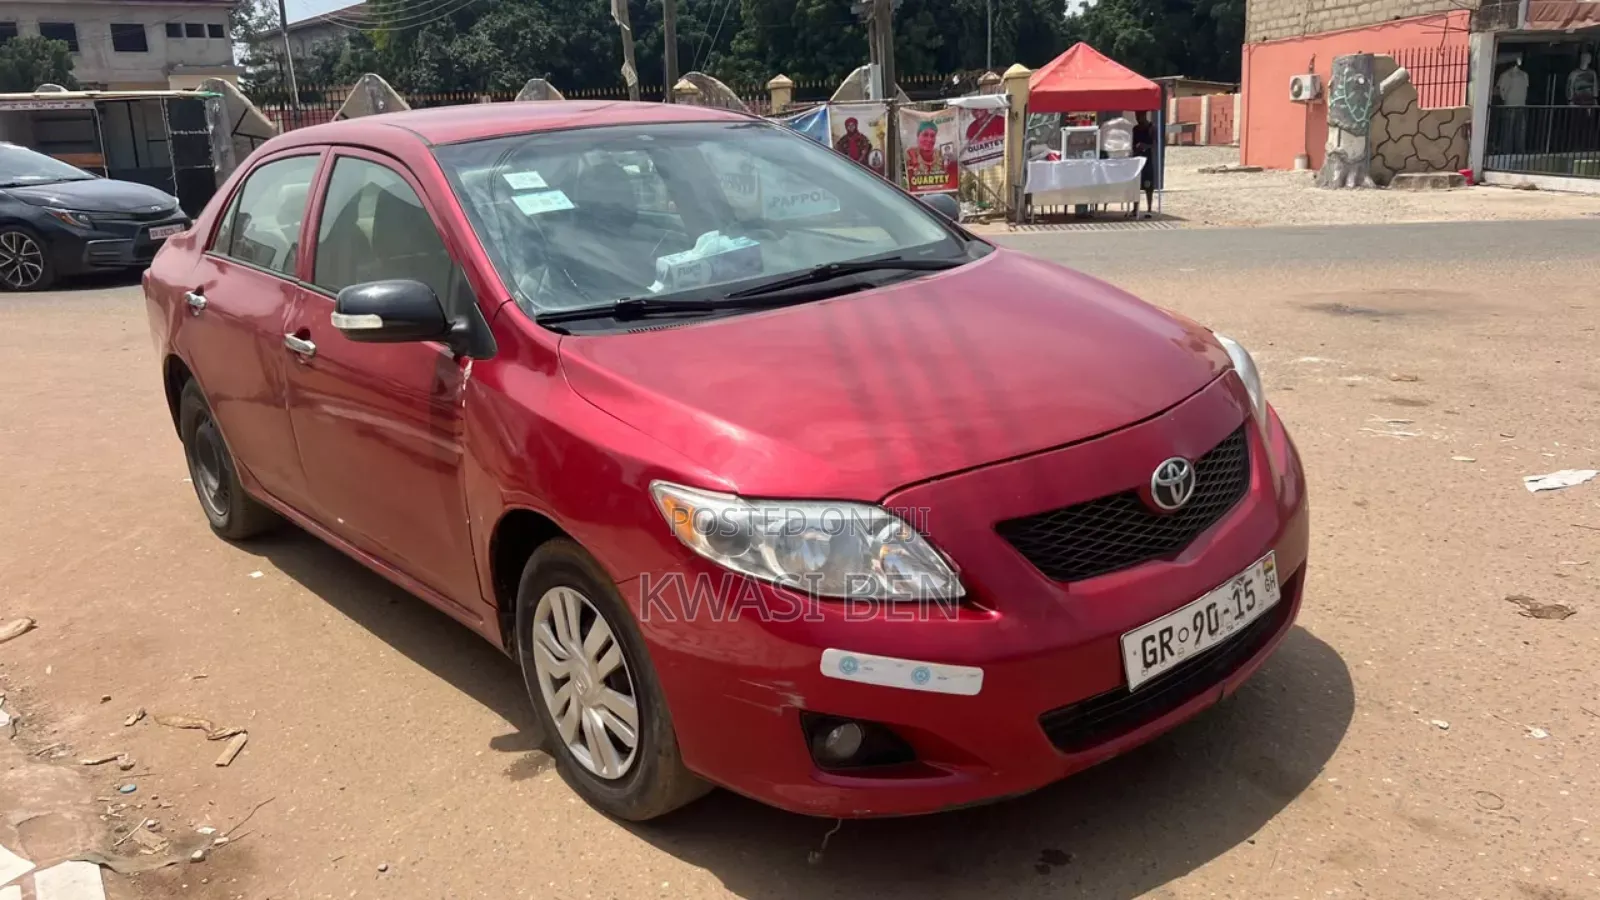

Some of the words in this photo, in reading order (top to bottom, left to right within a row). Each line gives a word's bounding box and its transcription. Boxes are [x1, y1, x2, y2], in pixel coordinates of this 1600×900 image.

[967, 139, 1004, 153] QUARTEY
[911, 173, 950, 186] QUARTEY
[1264, 573, 1276, 592] GH
[1141, 626, 1175, 669] GR
[1193, 579, 1256, 646] 90-15
